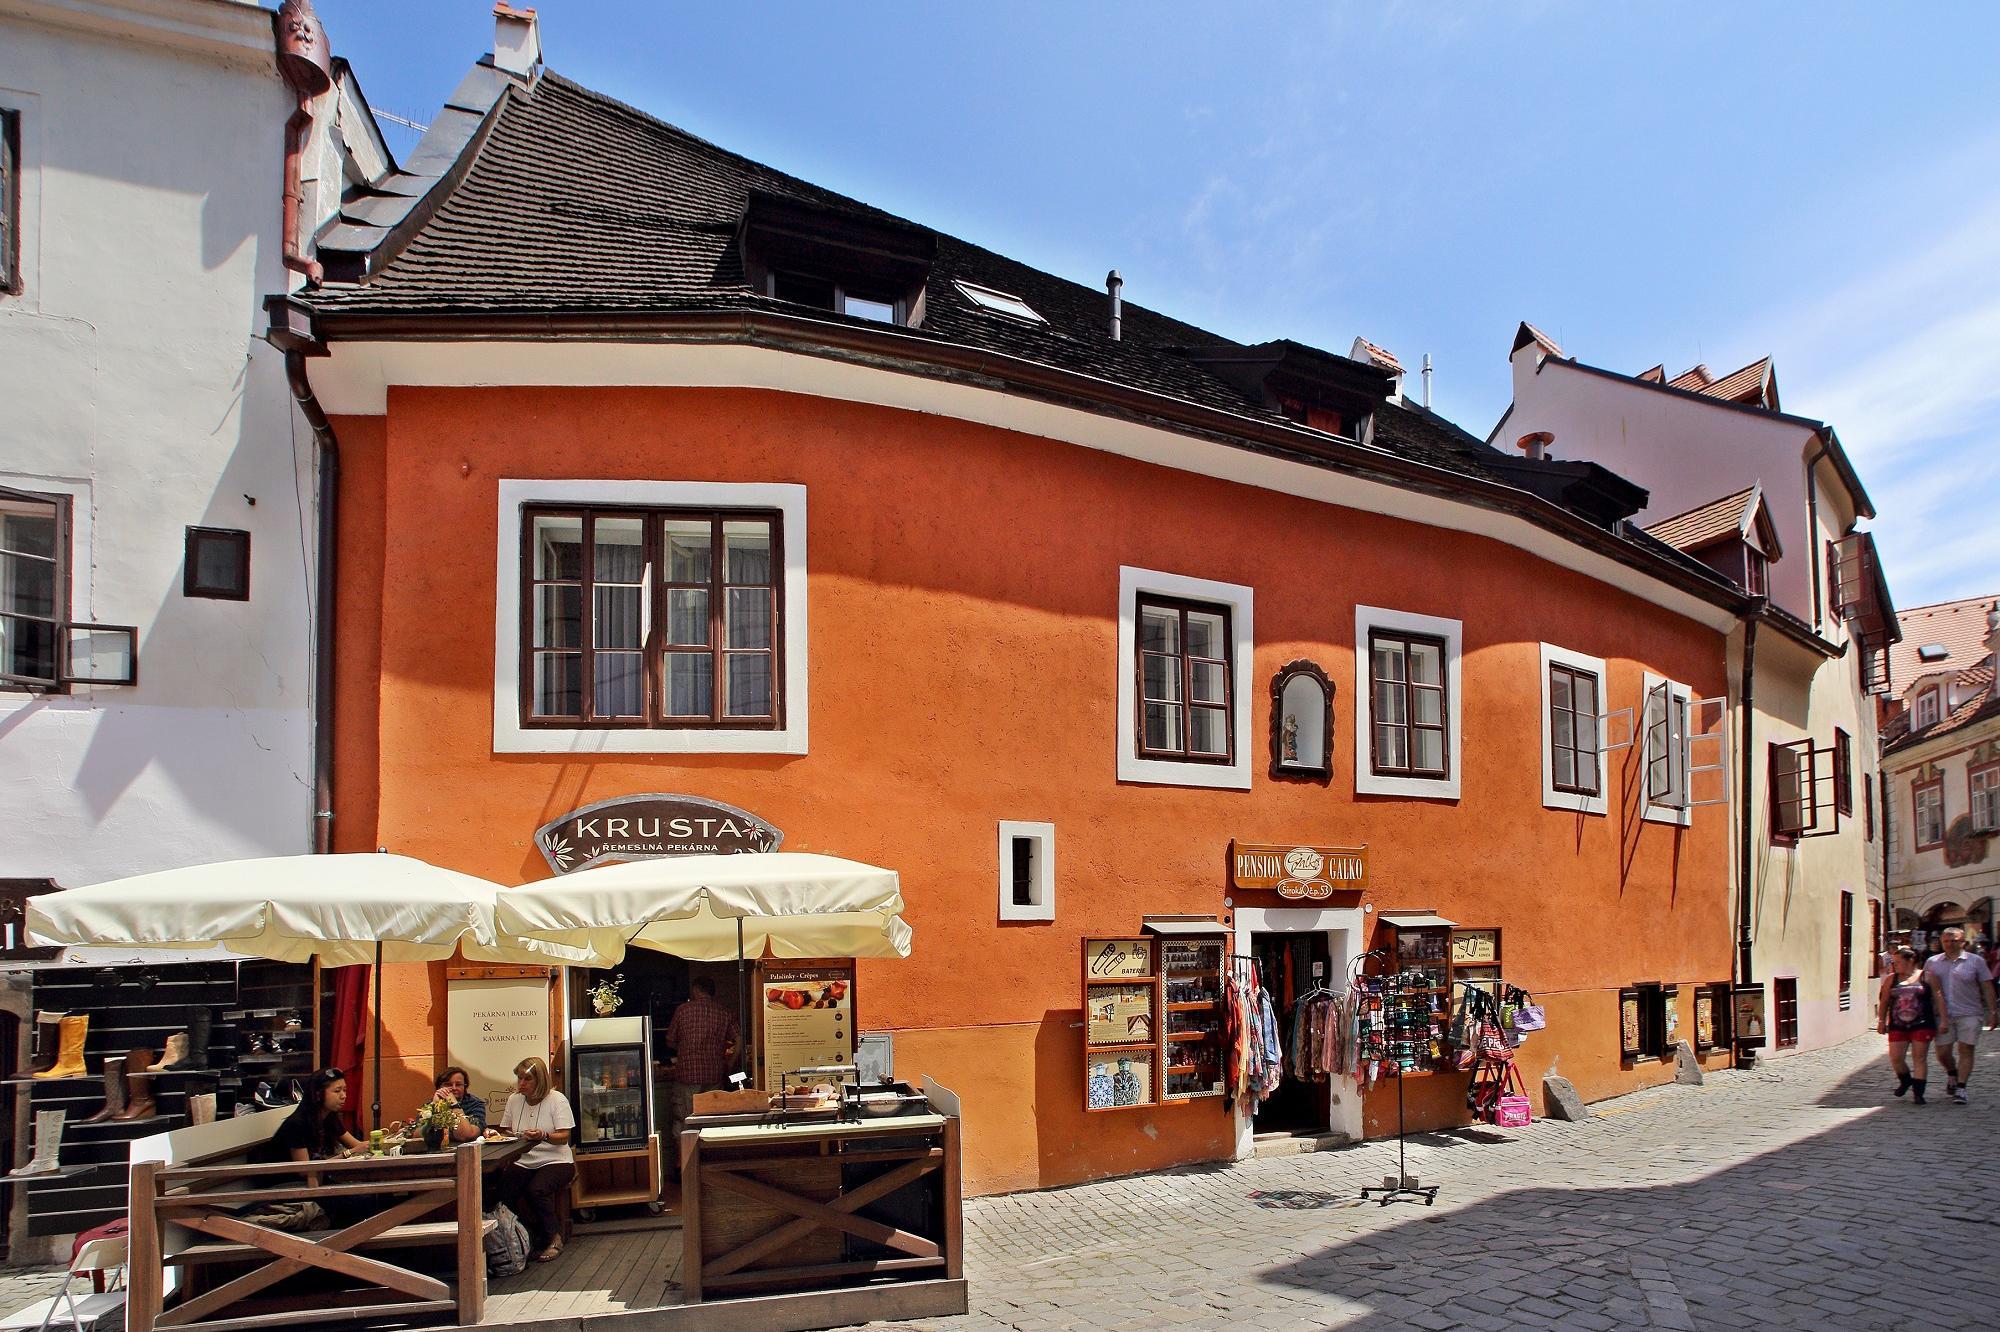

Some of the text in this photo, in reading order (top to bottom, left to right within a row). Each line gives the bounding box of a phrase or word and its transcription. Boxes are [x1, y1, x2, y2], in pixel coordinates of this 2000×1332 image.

[577, 818, 742, 838] KRUSTA
[602, 842, 718, 851] ŘEMESLNÁ PEKÁRNA
[1237, 855, 1281, 878] PENSION
[1329, 858, 1363, 880] GALKO
[1320, 885, 1329, 896] 53
[1121, 967, 1146, 975] BATERIE
[482, 1021, 495, 1032] &
